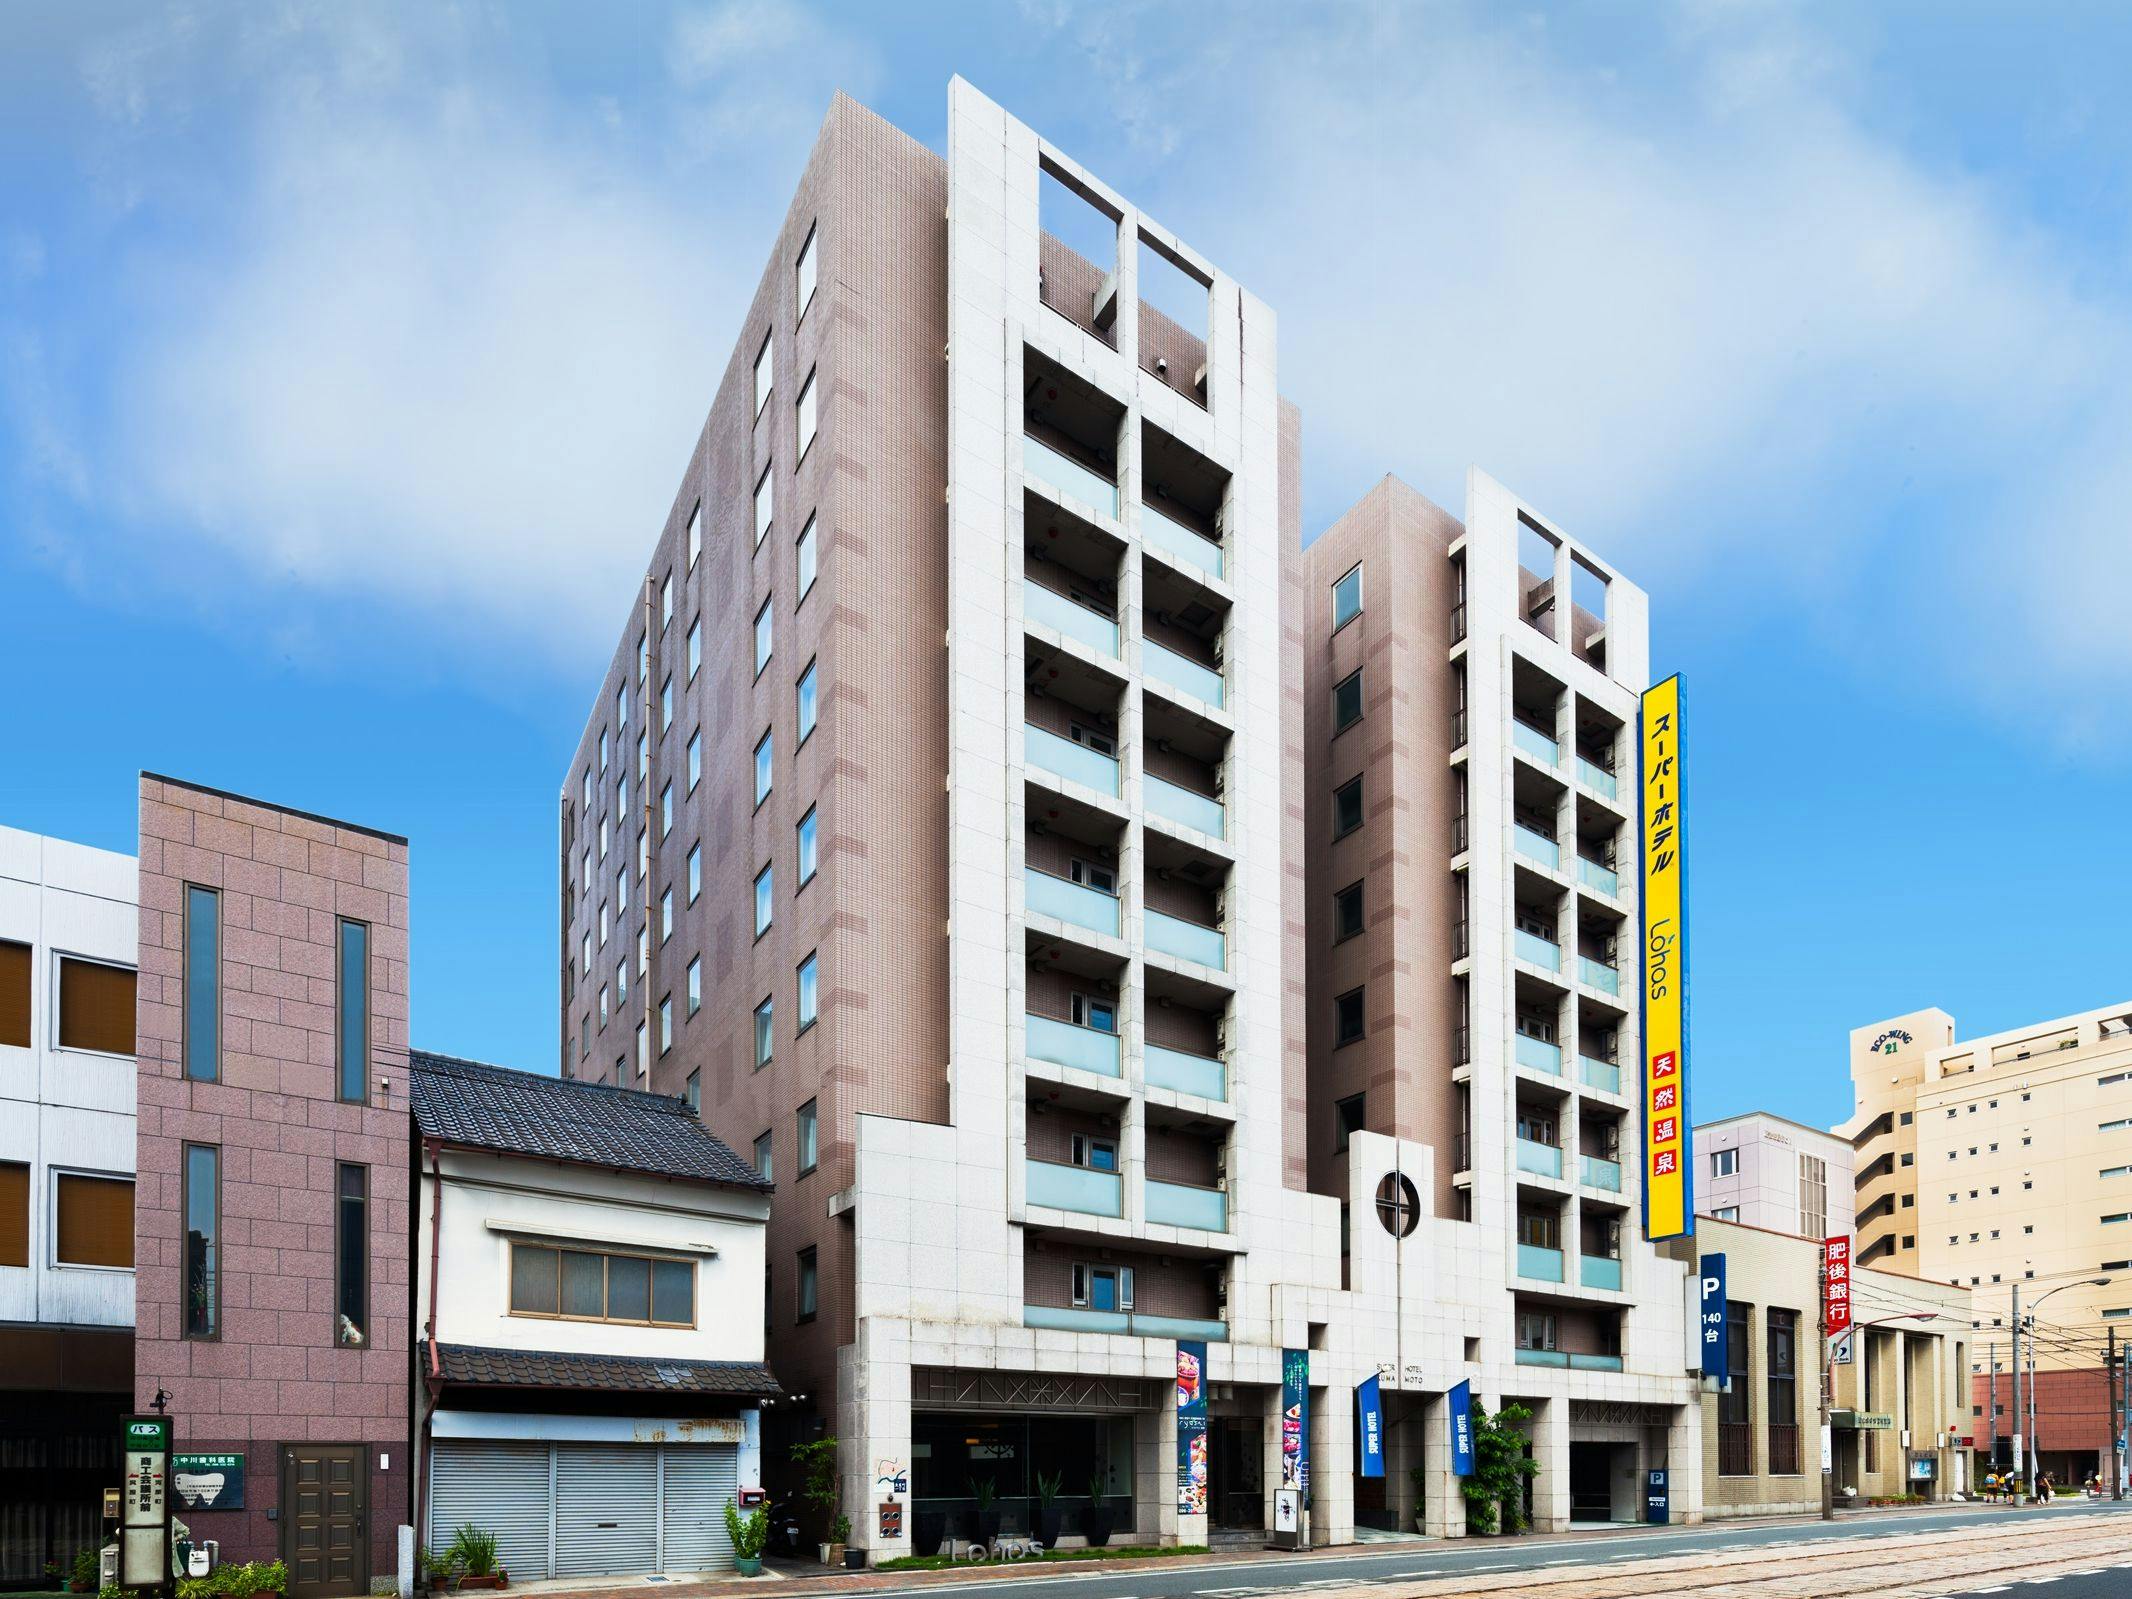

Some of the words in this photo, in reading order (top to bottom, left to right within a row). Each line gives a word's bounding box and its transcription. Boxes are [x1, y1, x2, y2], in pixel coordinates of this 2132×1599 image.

[1650, 713, 1674, 876] スーパーホテル
[1870, 1029, 1913, 1052] ECO-WING
[1885, 1042, 1898, 1055] 21
[1655, 1055, 1675, 1175] 天然温泉
[1702, 1277, 1720, 1300] P
[1829, 1242, 1848, 1320] 肥後銀行
[1702, 1312, 1722, 1325] 140
[1704, 1328, 1719, 1343] 台
[1405, 1376, 1423, 1384] MOTO
[133, 1425, 158, 1433] バス
[1367, 1411, 1377, 1432] HOTEL
[1457, 1413, 1467, 1433] HOTEL
[1368, 1433, 1379, 1454] SUPER
[1458, 1434, 1469, 1454] SUPER
[181, 1456, 235, 1464] 中川歯科医院
[1653, 1473, 1661, 1483] P
